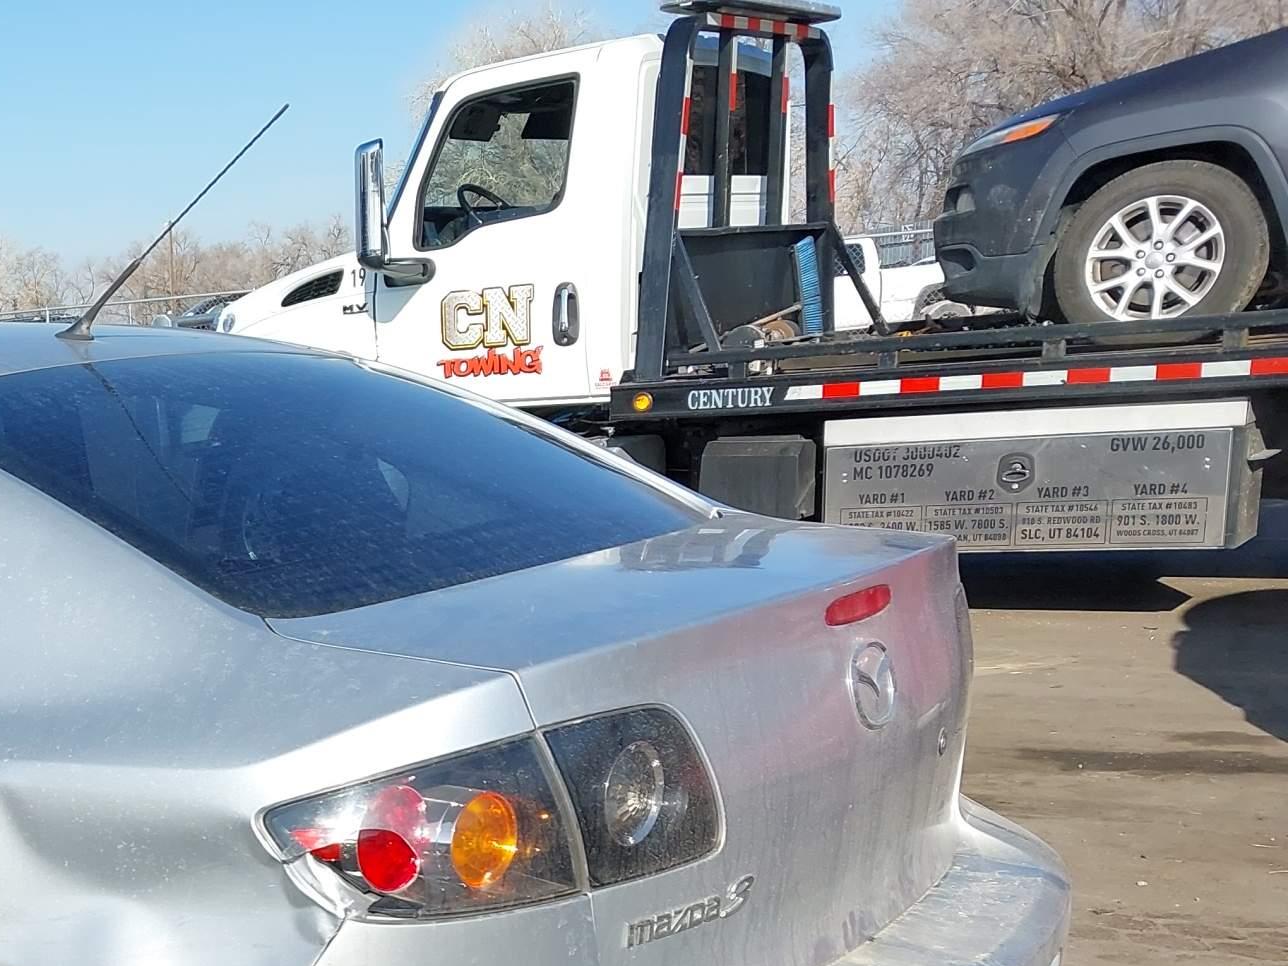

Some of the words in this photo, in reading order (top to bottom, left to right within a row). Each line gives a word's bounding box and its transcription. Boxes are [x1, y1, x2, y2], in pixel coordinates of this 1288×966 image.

[350, 267, 367, 288] 19
[441, 283, 534, 351] CN
[436, 345, 545, 379] TOWING
[687, 386, 775, 410] CENTURY
[1110, 437, 1148, 451] GVW
[1152, 434, 1205, 454] 26,000
[853, 465, 873, 480] MC
[878, 463, 934, 479] 1078269
[944, 489, 974, 502] YARD
[977, 489, 995, 500] #2
[1037, 486, 1068, 499] YARD
[1071, 486, 1089, 497] #3
[1133, 483, 1166, 496] YARD
[1169, 482, 1188, 495] #4
[858, 493, 887, 505] YARD
[889, 492, 905, 504] #1
[934, 508, 956, 516] STATE
[1025, 505, 1050, 513] STATE
[1051, 504, 1066, 513] TAX
[1121, 502, 1146, 511] STATE
[1148, 502, 1163, 510] TAX
[848, 511, 872, 519] STATE
[1117, 514, 1136, 526] 901
[1140, 514, 1150, 526] S.
[1155, 514, 1182, 525] 1800
[1184, 513, 1200, 525] W.
[928, 520, 952, 531] 1585
[954, 519, 968, 530] W.
[998, 518, 1009, 529] S.
[1021, 528, 1045, 542] SLC,
[1049, 528, 1064, 540] UT
[1066, 527, 1100, 539] 84104
